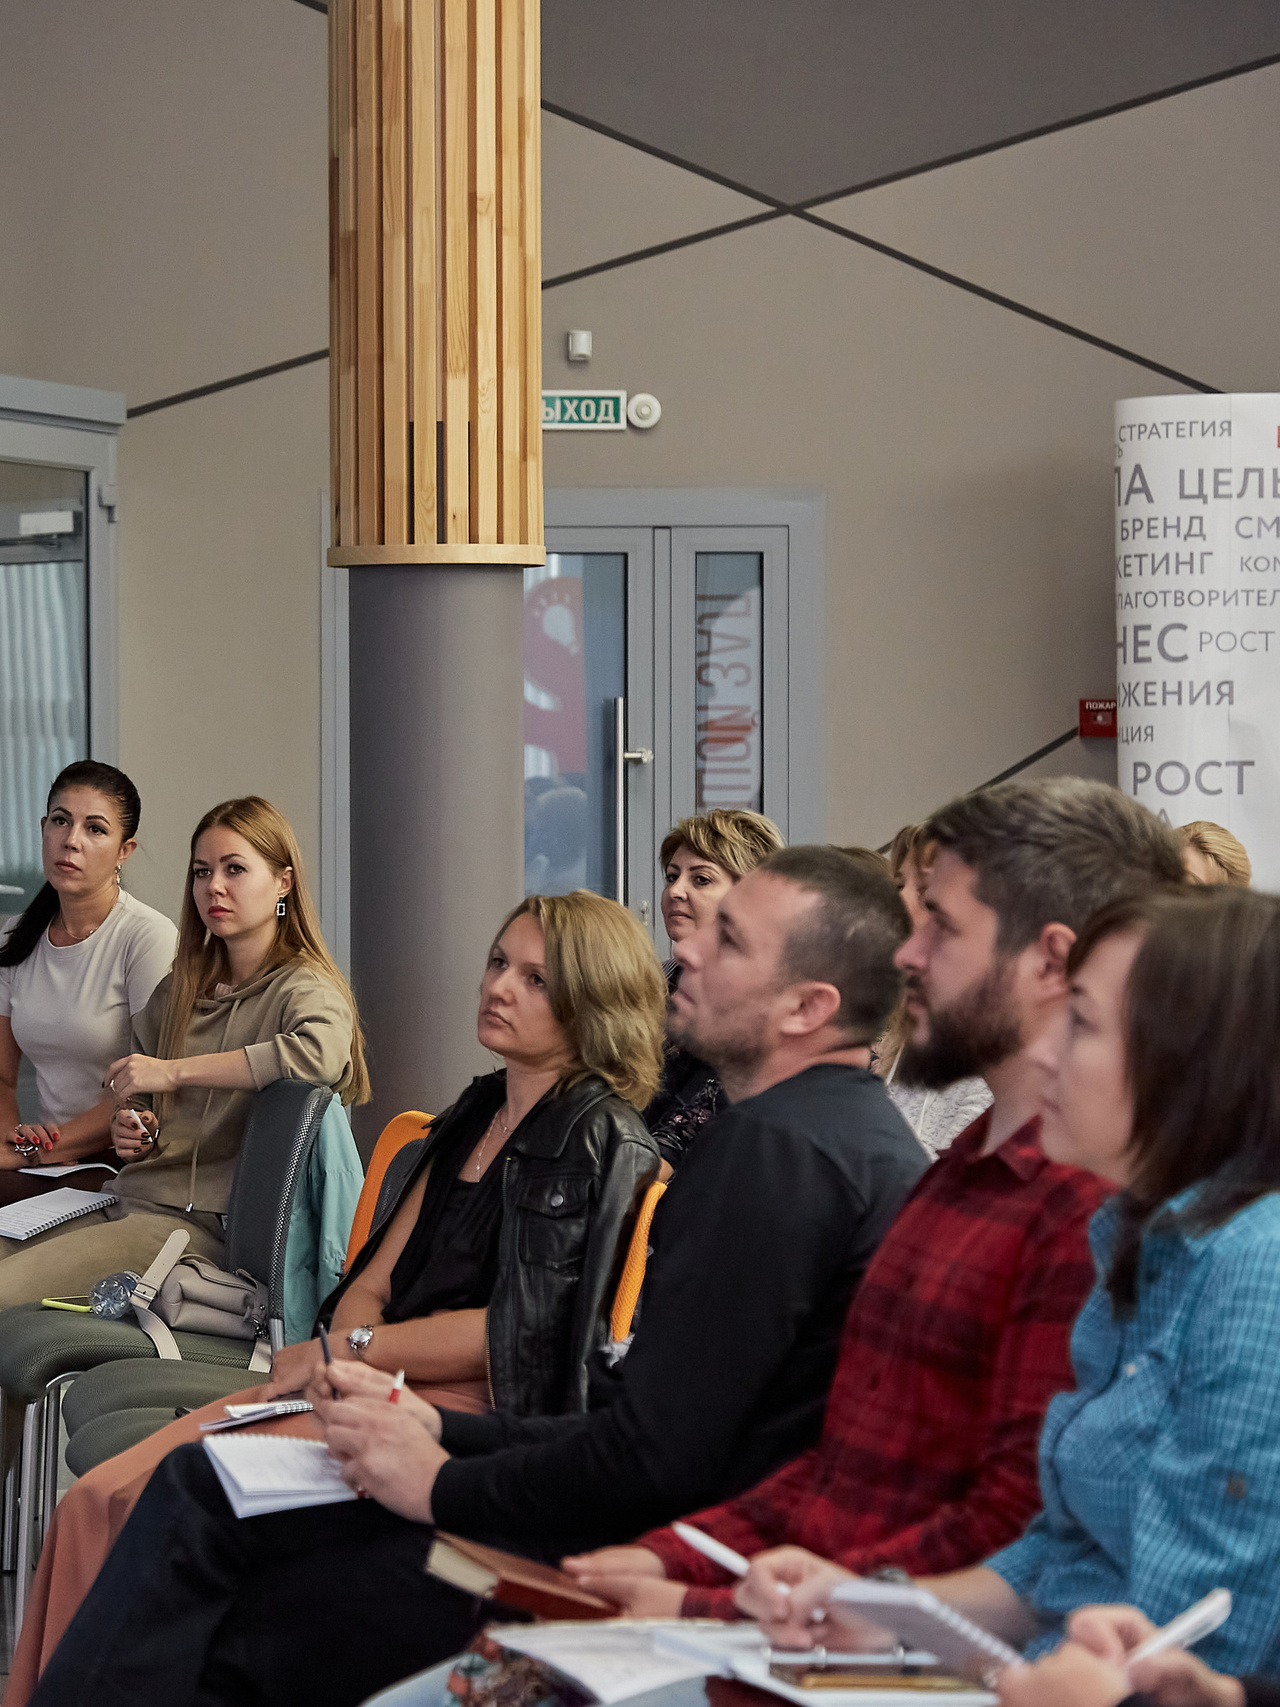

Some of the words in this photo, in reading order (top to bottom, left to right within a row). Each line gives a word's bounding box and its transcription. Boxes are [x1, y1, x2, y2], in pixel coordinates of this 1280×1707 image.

[1119, 420, 1232, 442] СТРАТЕГИЯ
[1121, 516, 1206, 541] БРЕНД
[1199, 631, 1276, 652] РОСТ
[1118, 681, 1234, 708] ЖЕНИЯ
[1132, 760, 1255, 796] РОСТ
